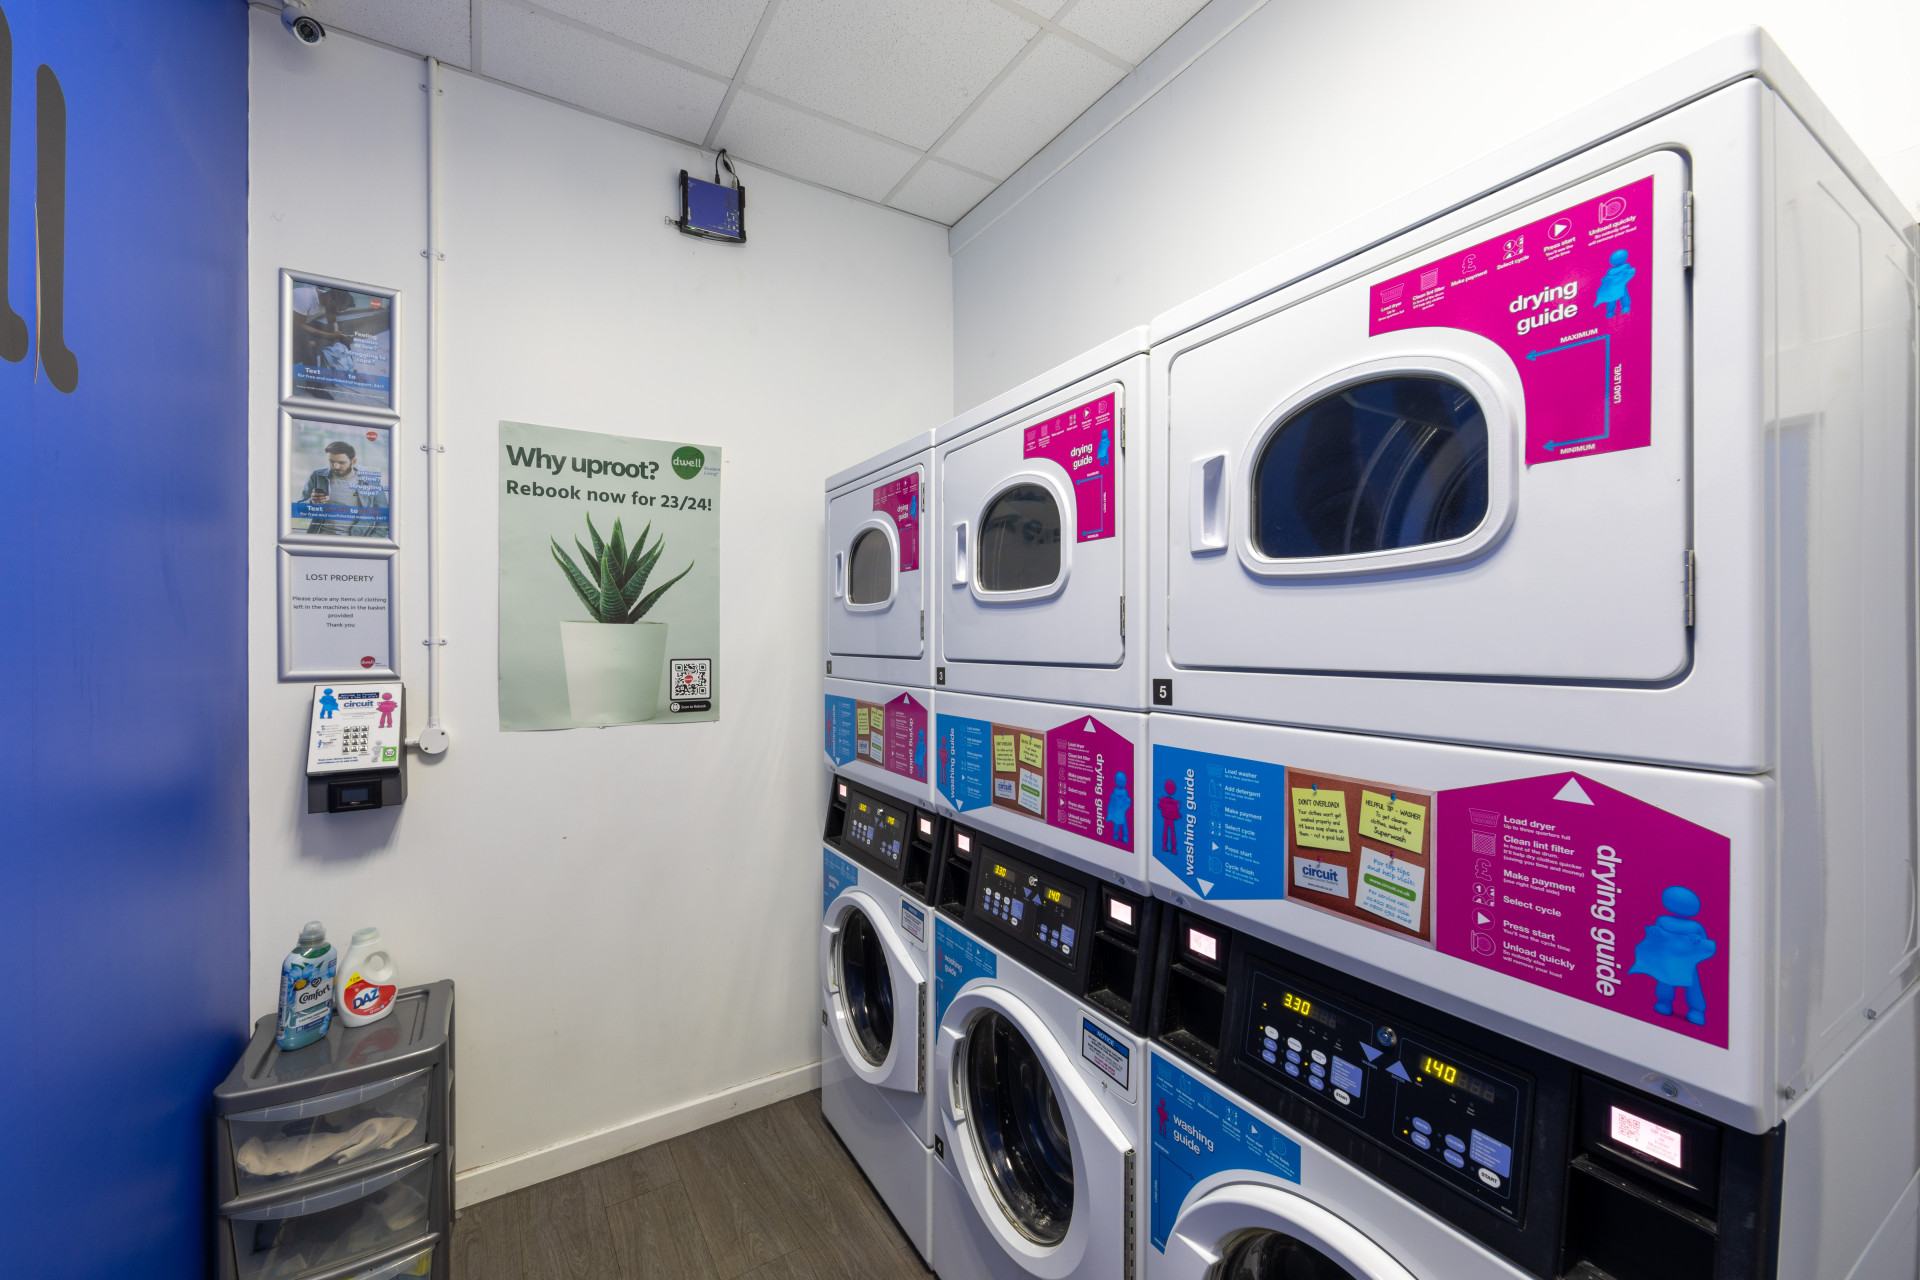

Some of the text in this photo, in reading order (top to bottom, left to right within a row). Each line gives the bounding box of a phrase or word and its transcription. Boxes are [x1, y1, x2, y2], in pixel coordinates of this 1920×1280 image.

[1589, 215, 1636, 236] Unload quickly
[1544, 237, 1576, 252] Press start
[1496, 255, 1529, 270] Select cycle
[1451, 270, 1487, 287] Make payment
[1413, 293, 1426, 301] Clean
[1509, 281, 1578, 313] drying
[1517, 304, 1578, 335] guide
[1560, 328, 1598, 343] MAXIMUM
[1614, 364, 1622, 383] LEVEL
[1070, 443, 1093, 457] drying
[1560, 443, 1595, 454] MINIMUM
[506, 445, 659, 480] Why uproot?
[673, 454, 701, 467] dwell
[1073, 455, 1093, 470] guide
[506, 480, 712, 512] Rebook now for 23/24!
[331, 574, 374, 582] PROPERTY
[939, 671, 943, 681] 3
[1160, 686, 1167, 698] 5
[344, 700, 374, 708] circuit
[1238, 771, 1257, 779] washer
[1095, 754, 1104, 835] drying guide
[1236, 788, 1260, 798] detergent
[1366, 799, 1384, 810] HELPFUL
[1225, 806, 1238, 815] Make
[1240, 811, 1262, 821] payment
[1391, 817, 1408, 825] cleaner
[1184, 769, 1197, 876] washing guide
[1225, 823, 1240, 832] Select
[1242, 828, 1255, 836] cycle
[1389, 824, 1402, 832] select
[1504, 815, 1556, 831] Load dryer
[1374, 826, 1406, 843] Superwash
[1520, 826, 1534, 834] three
[1536, 830, 1560, 839] quarters
[1225, 845, 1252, 858] Press start
[1504, 834, 1575, 855] Clean lint filter
[1510, 844, 1523, 852] front
[1225, 862, 1254, 876] Cycle finish
[1302, 864, 1338, 882] circuit
[1374, 858, 1410, 877] For top tips
[1367, 865, 1415, 887] and help visit:
[1504, 869, 1576, 893] Make payment
[1503, 895, 1561, 917] Select cycle
[1590, 845, 1622, 997] drying guide
[1504, 920, 1555, 942] Press start
[1503, 928, 1518, 937] You'll
[1541, 940, 1556, 948] cycle
[1557, 944, 1570, 953] time
[945, 955, 962, 973] washing
[1503, 941, 1575, 971] Unload quickly
[1511, 952, 1532, 963] nobody
[1533, 959, 1545, 967] else
[945, 964, 956, 977] guide
[1513, 959, 1534, 969] remove
[1535, 966, 1548, 974] your
[1549, 970, 1562, 979] load
[299, 984, 330, 1004] Comfort
[352, 988, 379, 1010] DAZ
[1284, 992, 1311, 1016] 3.30
[1097, 1030, 1115, 1046] NOTICE
[1426, 1057, 1456, 1084] 1.40
[1336, 1092, 1348, 1102] START
[1174, 1115, 1214, 1152] washing
[1174, 1130, 1200, 1154] guide
[1481, 1172, 1498, 1184] START
